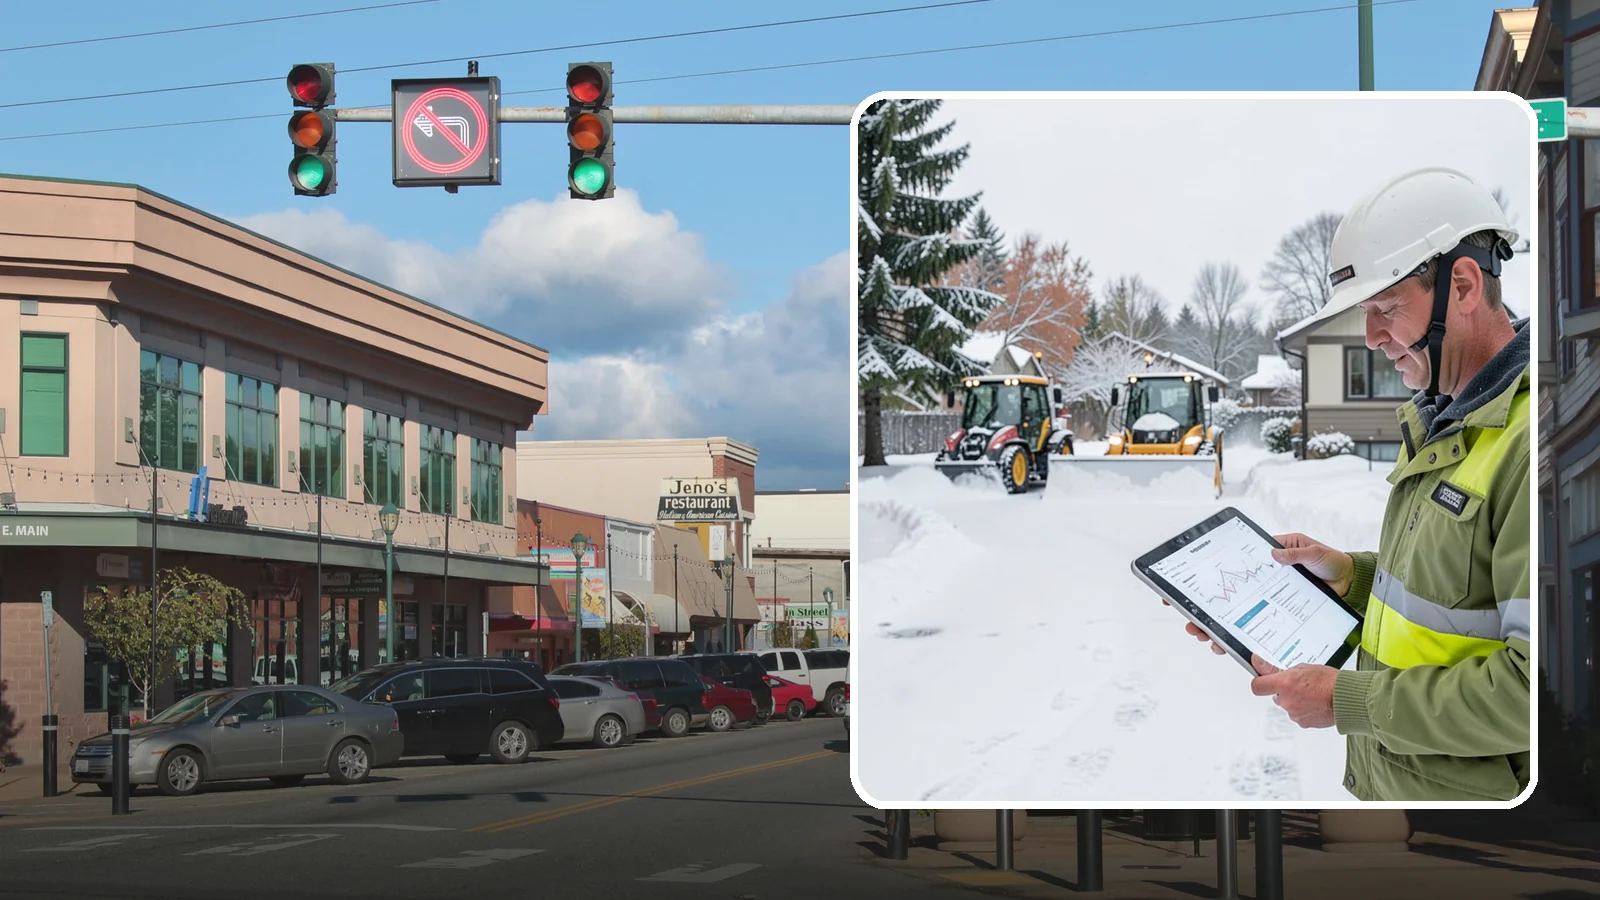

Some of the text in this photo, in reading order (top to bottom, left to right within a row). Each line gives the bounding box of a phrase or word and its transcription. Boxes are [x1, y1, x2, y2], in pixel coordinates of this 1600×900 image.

[669, 479, 728, 495] Jeno's
[665, 496, 731, 509] restaurant
[686, 509, 715, 520] American
[715, 509, 738, 519] Cuisine
[2, 525, 49, 536] E. MAIN
[797, 607, 829, 617] Street
